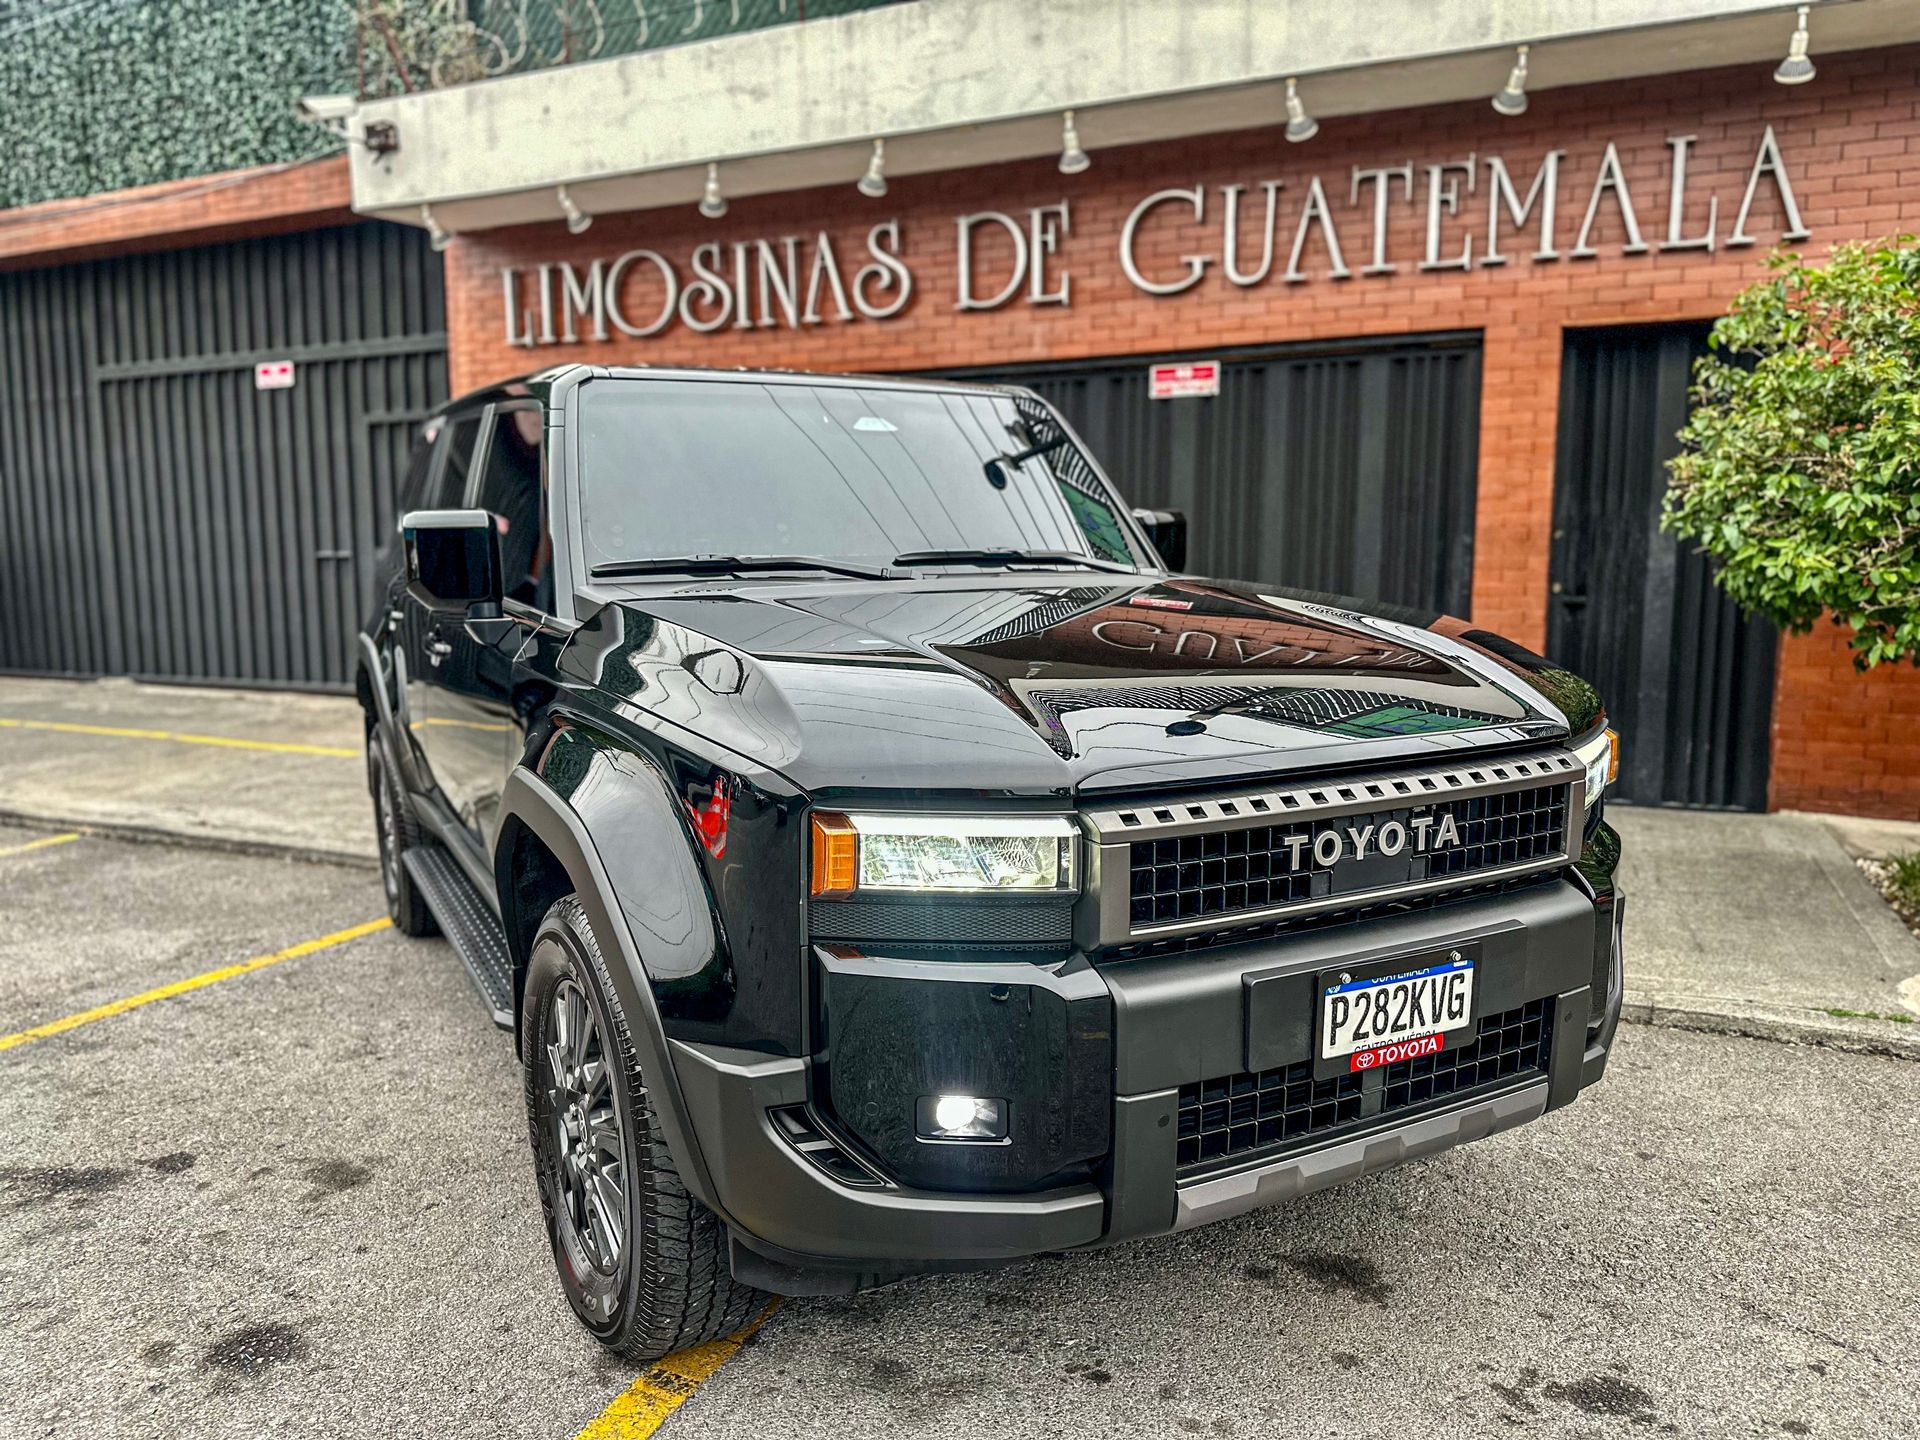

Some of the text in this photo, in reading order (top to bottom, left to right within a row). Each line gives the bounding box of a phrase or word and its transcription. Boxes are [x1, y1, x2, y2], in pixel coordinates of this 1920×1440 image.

[502, 124, 1812, 347] LIMOSINAS DE GUATEMALA
[1283, 813, 1461, 871] TOYOTA
[1329, 972, 1466, 1047] P282KVG
[1377, 1037, 1438, 1064] TOYOTA
